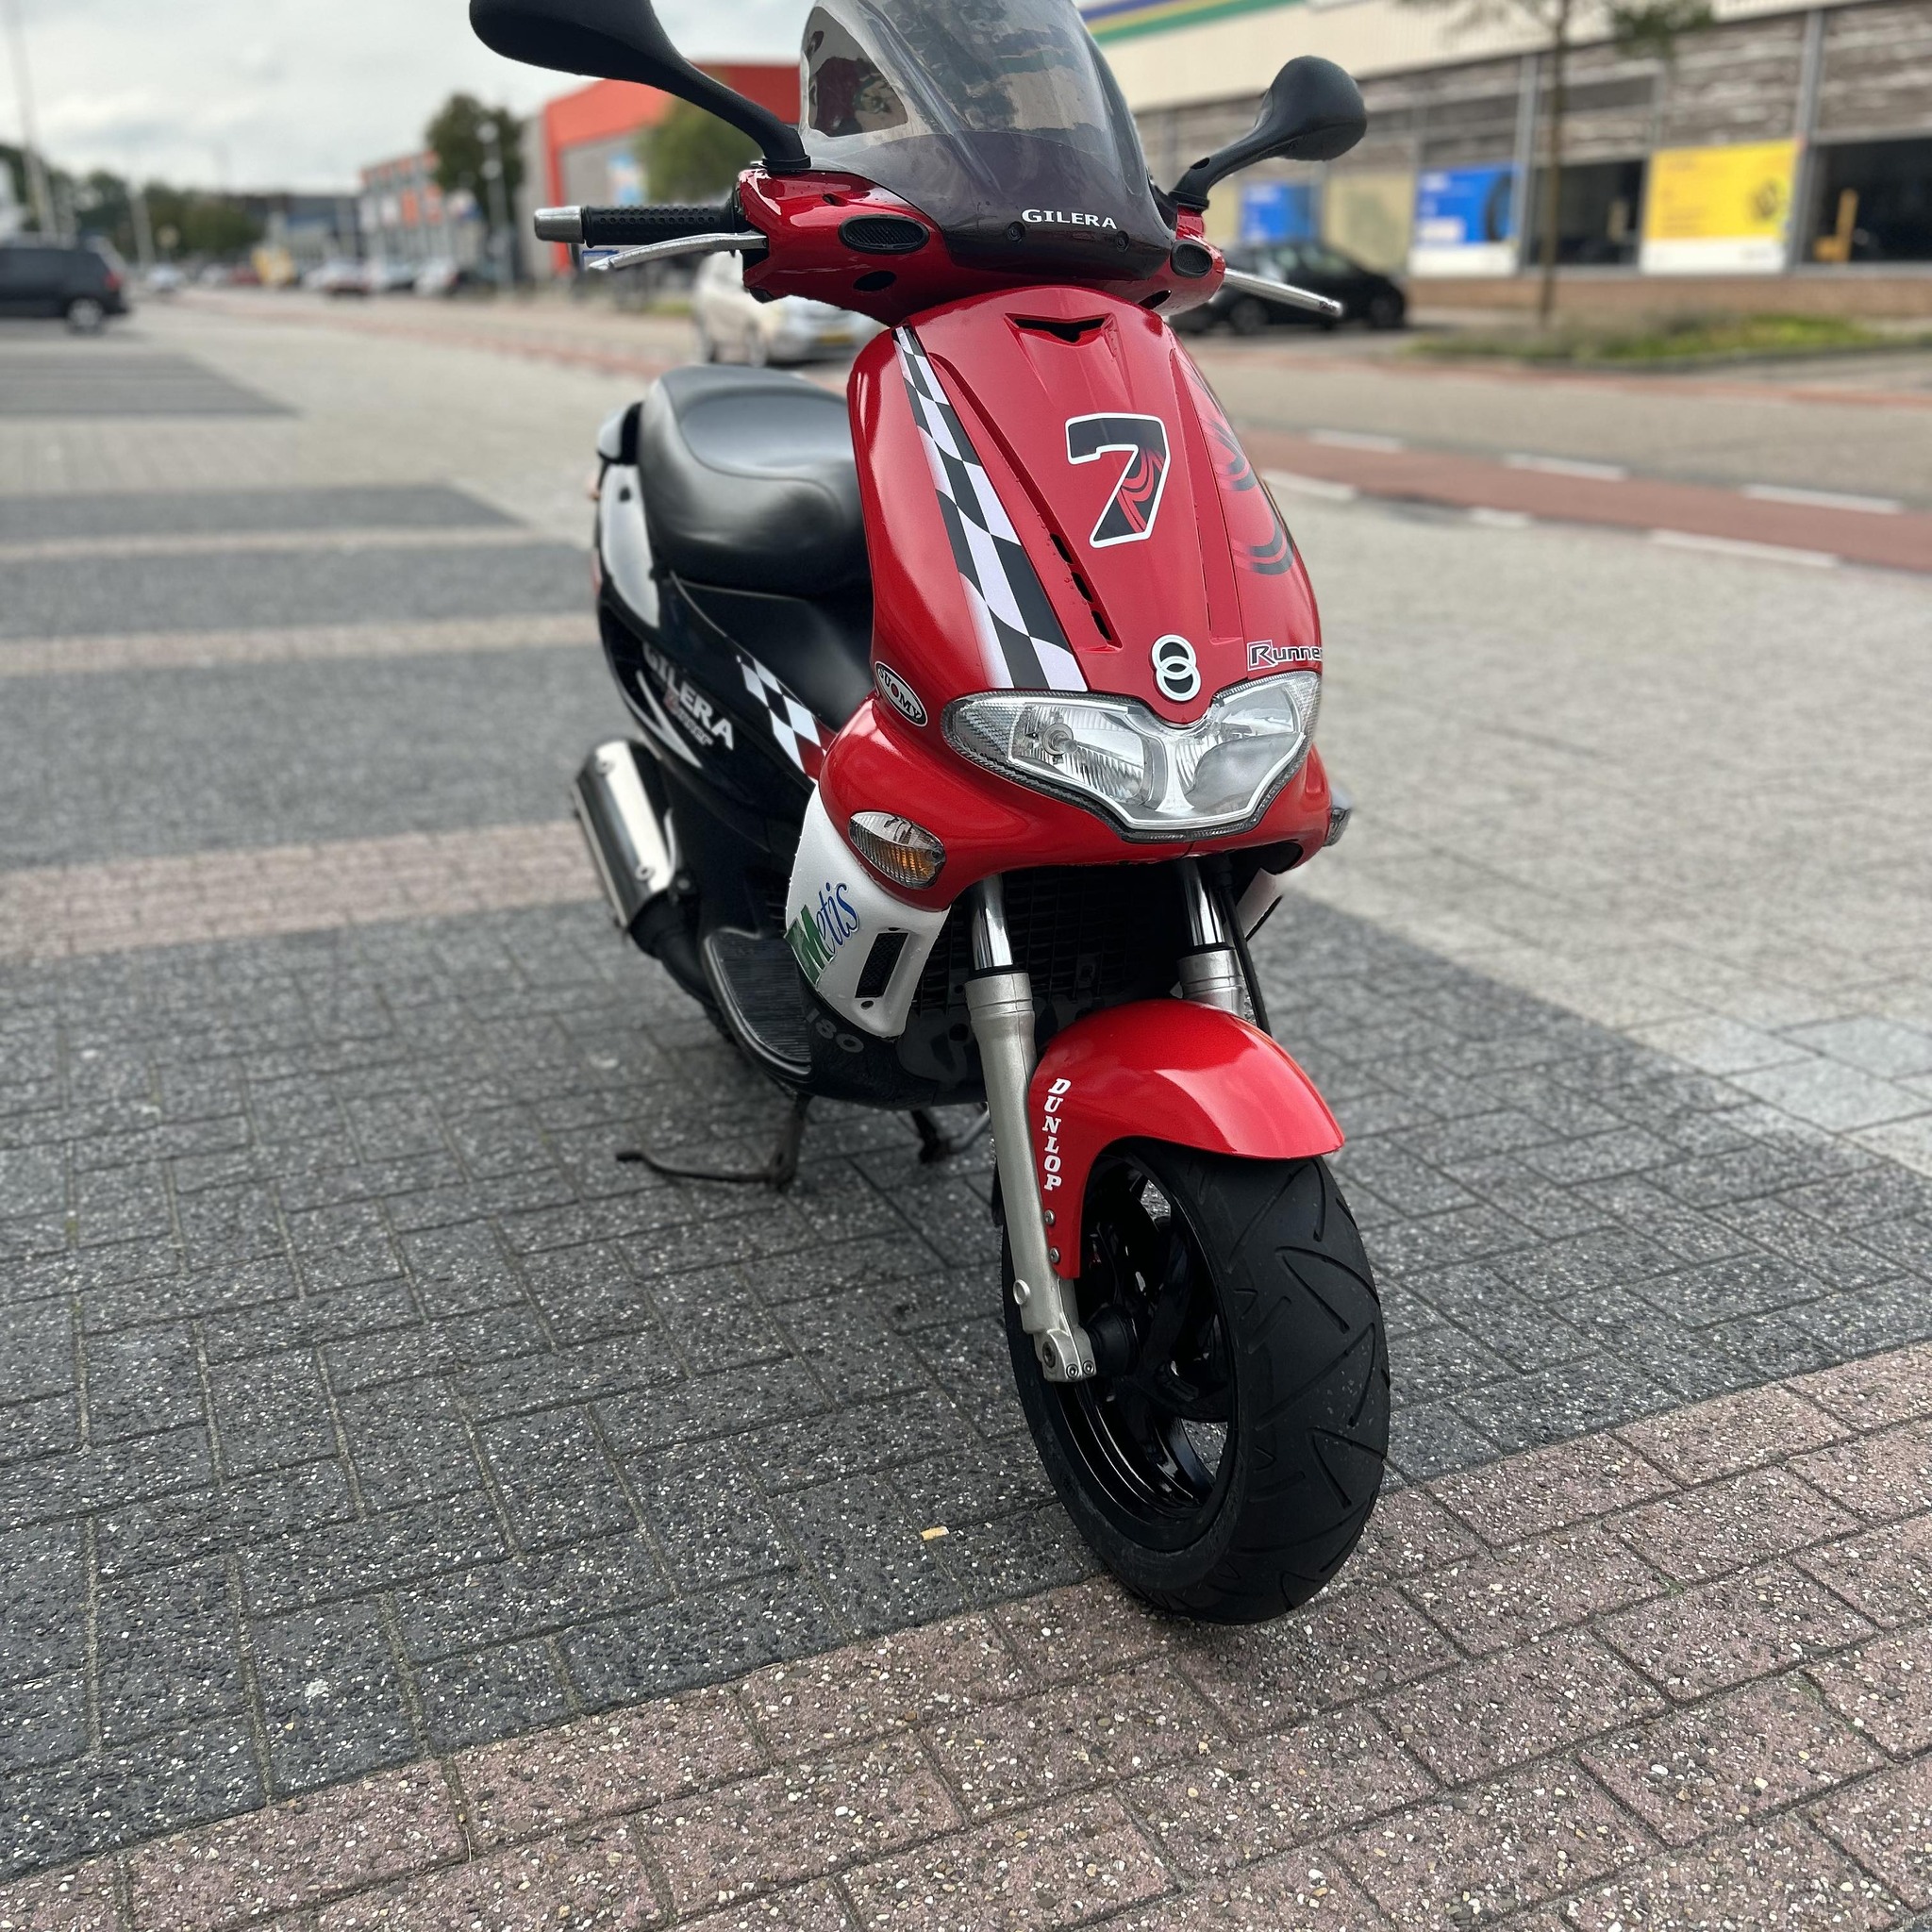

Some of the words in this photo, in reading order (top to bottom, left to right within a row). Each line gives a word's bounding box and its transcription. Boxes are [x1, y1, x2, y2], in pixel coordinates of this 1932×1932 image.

[1022, 208, 1118, 230] GILERA
[1065, 411, 1172, 549] 7
[877, 665, 922, 718] SUOMY
[1247, 639, 1323, 671] Runne
[642, 640, 734, 751] GILERA
[783, 881, 859, 989] Metis
[805, 1007, 865, 1054] 180
[1041, 1077, 1072, 1191] DUNLOP
